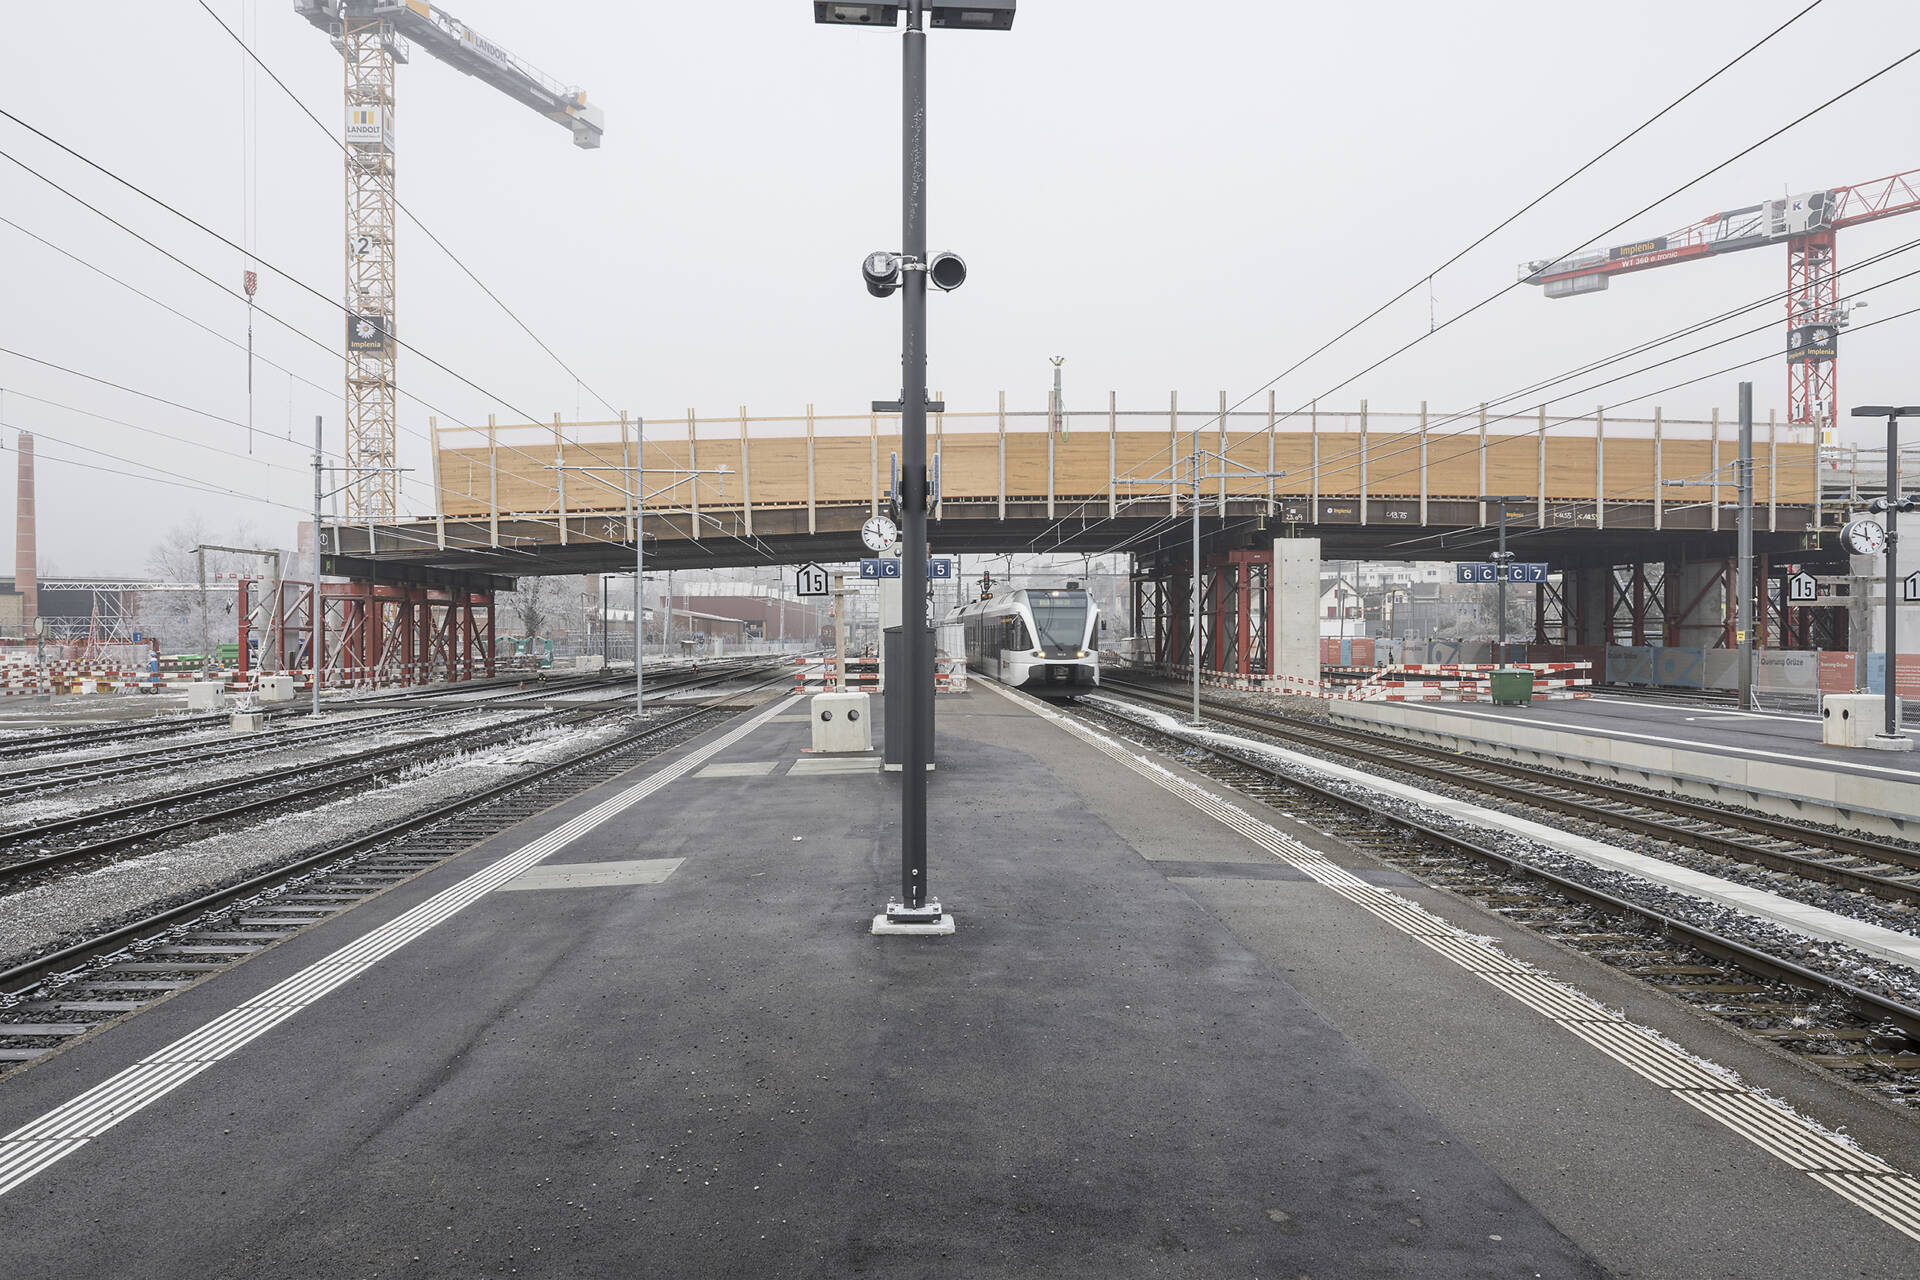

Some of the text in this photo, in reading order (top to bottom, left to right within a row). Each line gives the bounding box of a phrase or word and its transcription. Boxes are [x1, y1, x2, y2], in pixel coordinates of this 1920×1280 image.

[475, 36, 507, 63] LANDOLT
[357, 237, 369, 254] 2
[1620, 240, 1655, 257] Implenia
[350, 341, 381, 350] Implenia
[1807, 348, 1835, 356] Implenia
[866, 565, 874, 575] 4
[885, 565, 895, 575] C
[937, 565, 945, 575] 5
[1463, 569, 1472, 580] 6
[1483, 569, 1492, 579] C
[1513, 569, 1522, 579] C
[1533, 569, 1542, 580] 7
[803, 570, 822, 592] 15
[1795, 577, 1812, 597] 15
